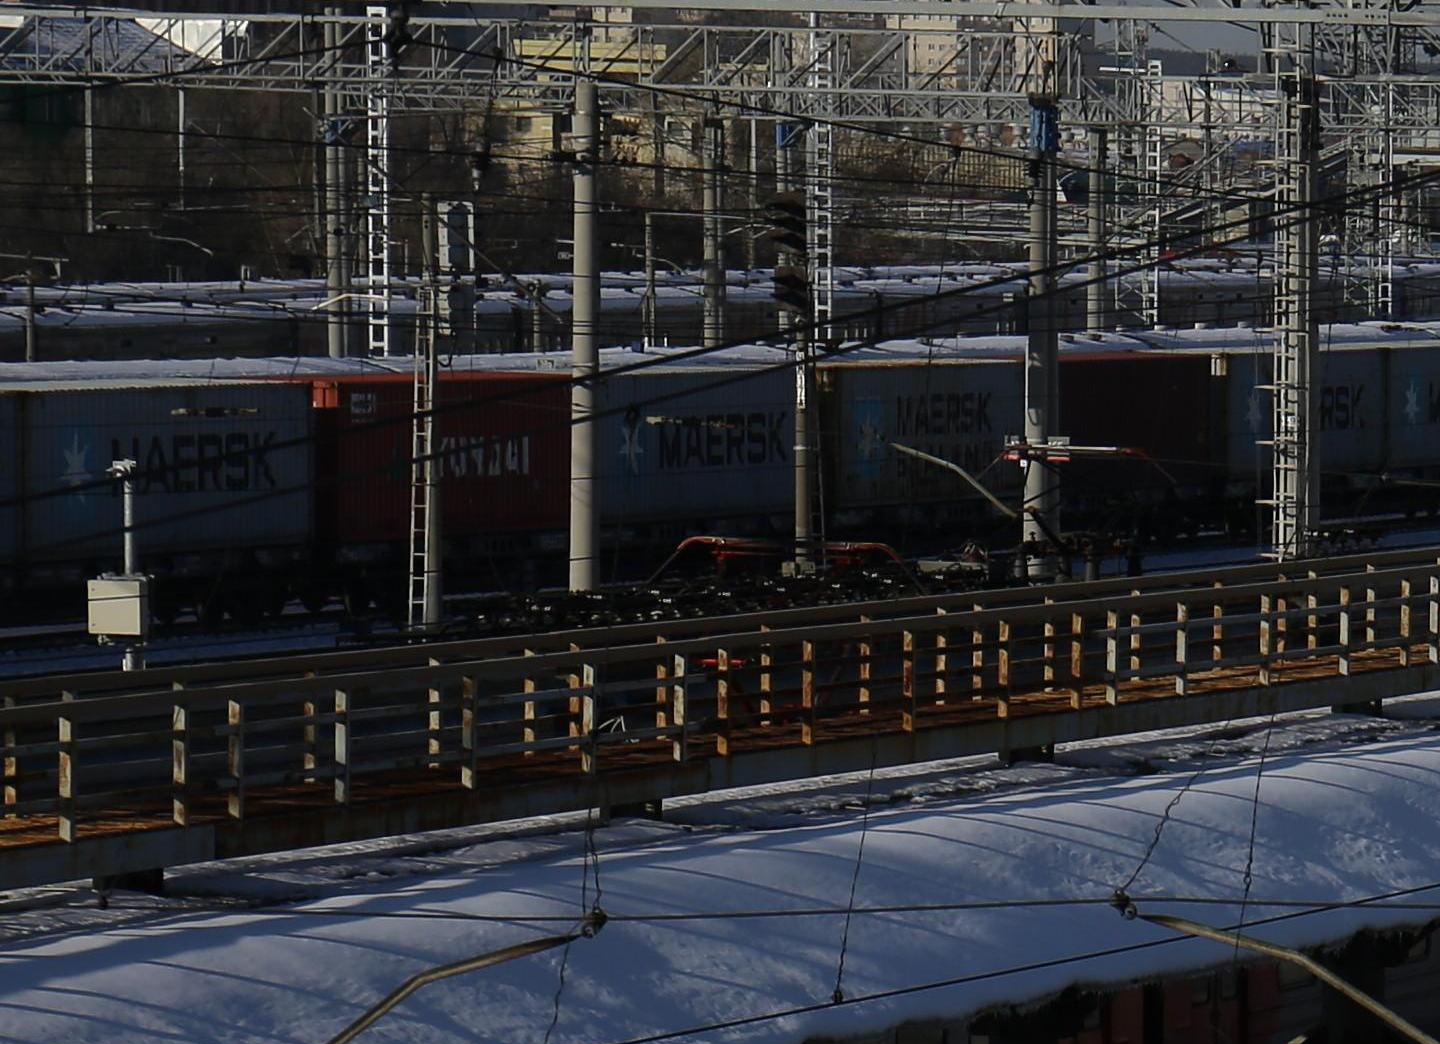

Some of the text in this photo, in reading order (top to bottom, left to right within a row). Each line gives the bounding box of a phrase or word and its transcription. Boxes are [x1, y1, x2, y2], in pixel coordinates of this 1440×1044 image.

[896, 392, 992, 436] MAERSK
[1320, 384, 1365, 430] RSK
[111, 431, 277, 498] MAERSK
[658, 411, 788, 469] MAERSK
